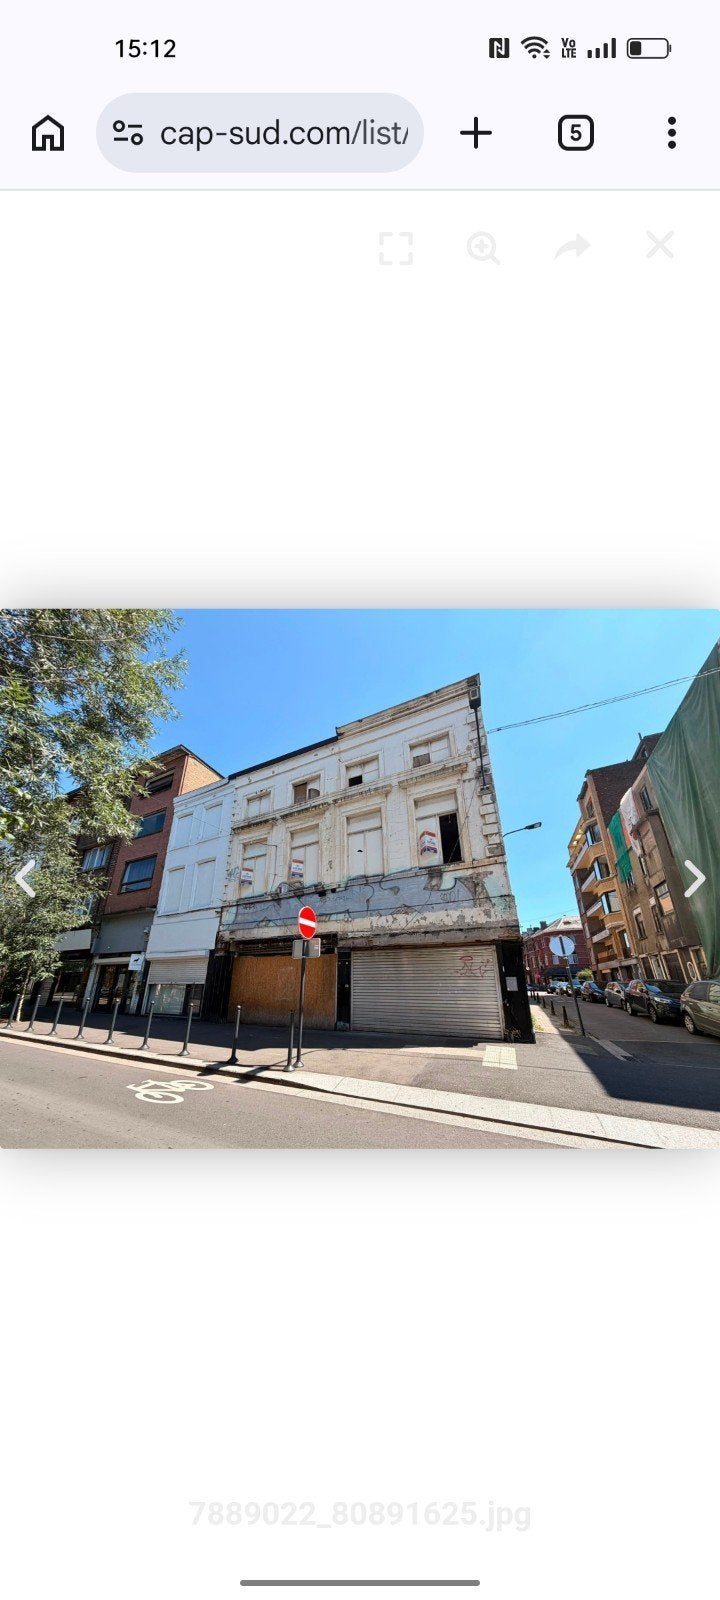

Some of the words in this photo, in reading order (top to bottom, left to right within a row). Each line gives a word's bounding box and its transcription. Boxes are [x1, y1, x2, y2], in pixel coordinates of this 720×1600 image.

[115, 39, 176, 58] 15:12
[561, 37, 576, 48] Vo
[561, 48, 577, 58] LTE
[160, 119, 409, 151] cap-sud.com/list/
[570, 124, 583, 142] 5
[188, 1500, 531, 1533] 7889022_80891625.jpg
